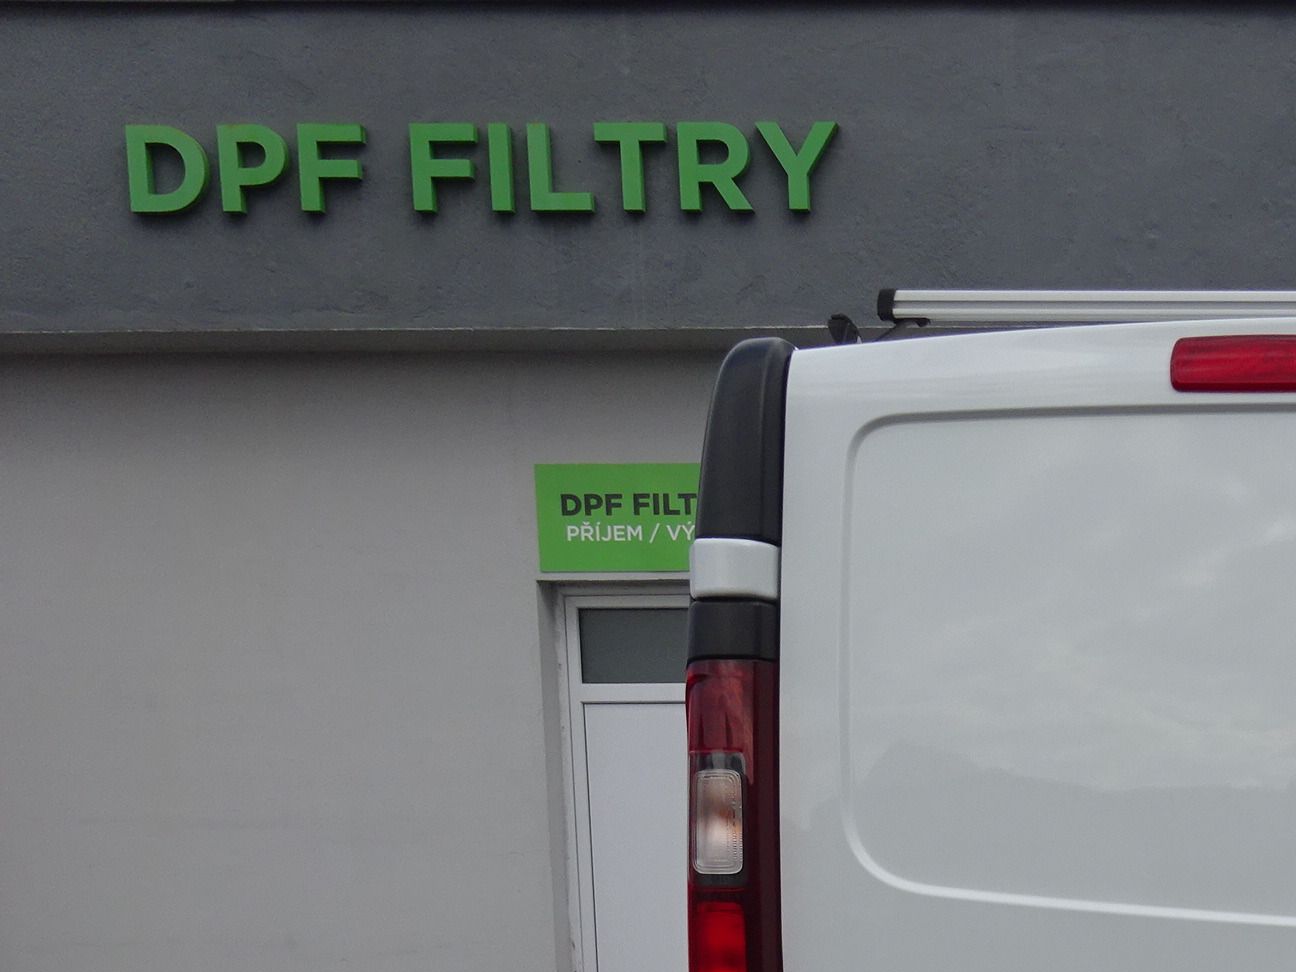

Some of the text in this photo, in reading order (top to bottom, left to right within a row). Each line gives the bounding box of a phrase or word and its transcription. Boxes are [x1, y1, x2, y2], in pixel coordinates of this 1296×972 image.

[125, 121, 839, 214] DPF FILTRY
[560, 493, 698, 517] DPF FILT
[566, 521, 643, 542] PŘÍJEM
